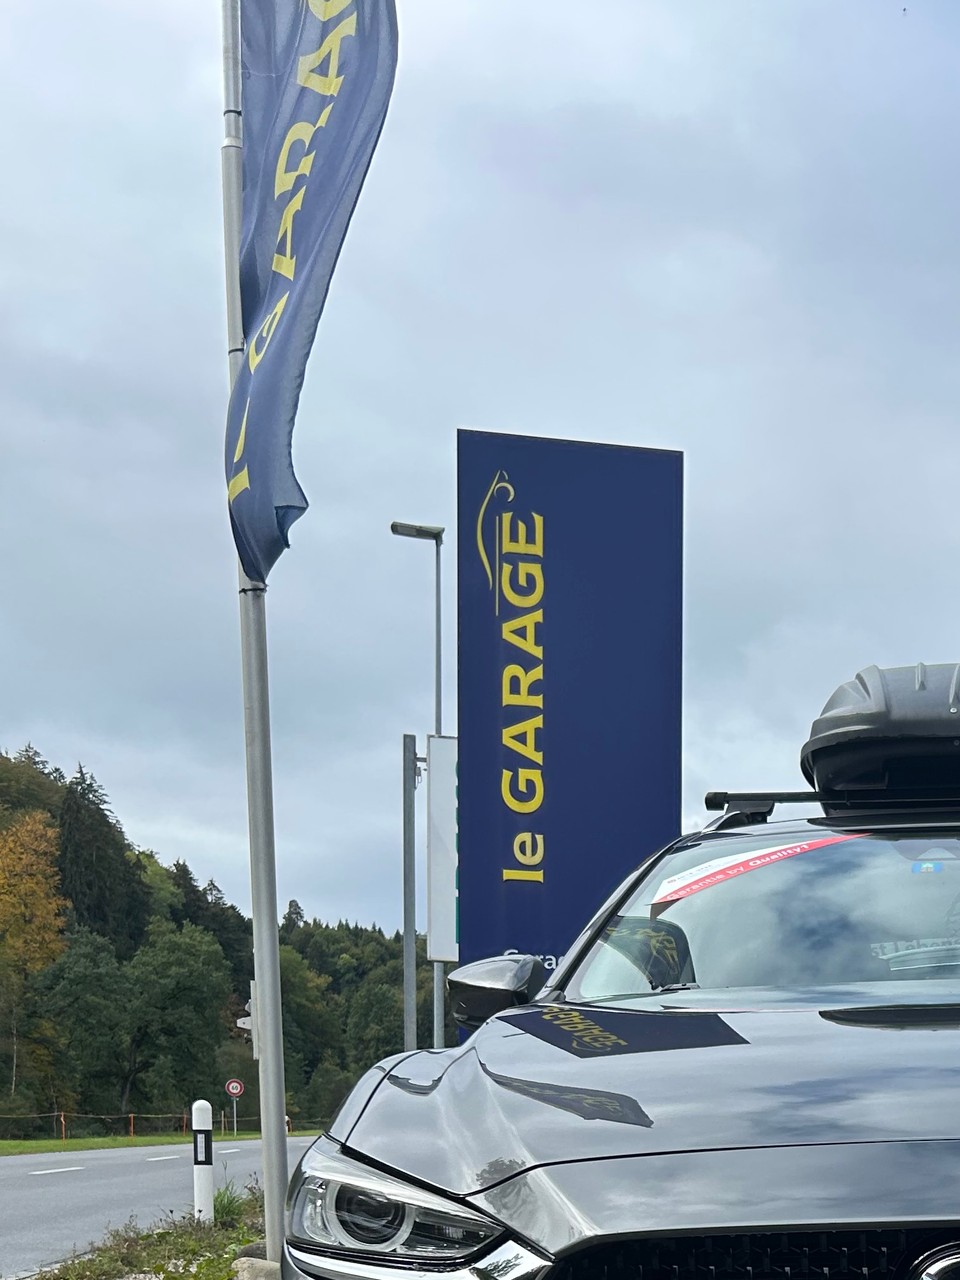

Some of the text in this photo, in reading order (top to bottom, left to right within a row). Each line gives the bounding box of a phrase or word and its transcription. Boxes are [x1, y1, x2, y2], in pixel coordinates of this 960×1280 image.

[501, 512, 544, 883] le GARAGE
[667, 873, 725, 900] Garantie
[729, 865, 745, 876] by
